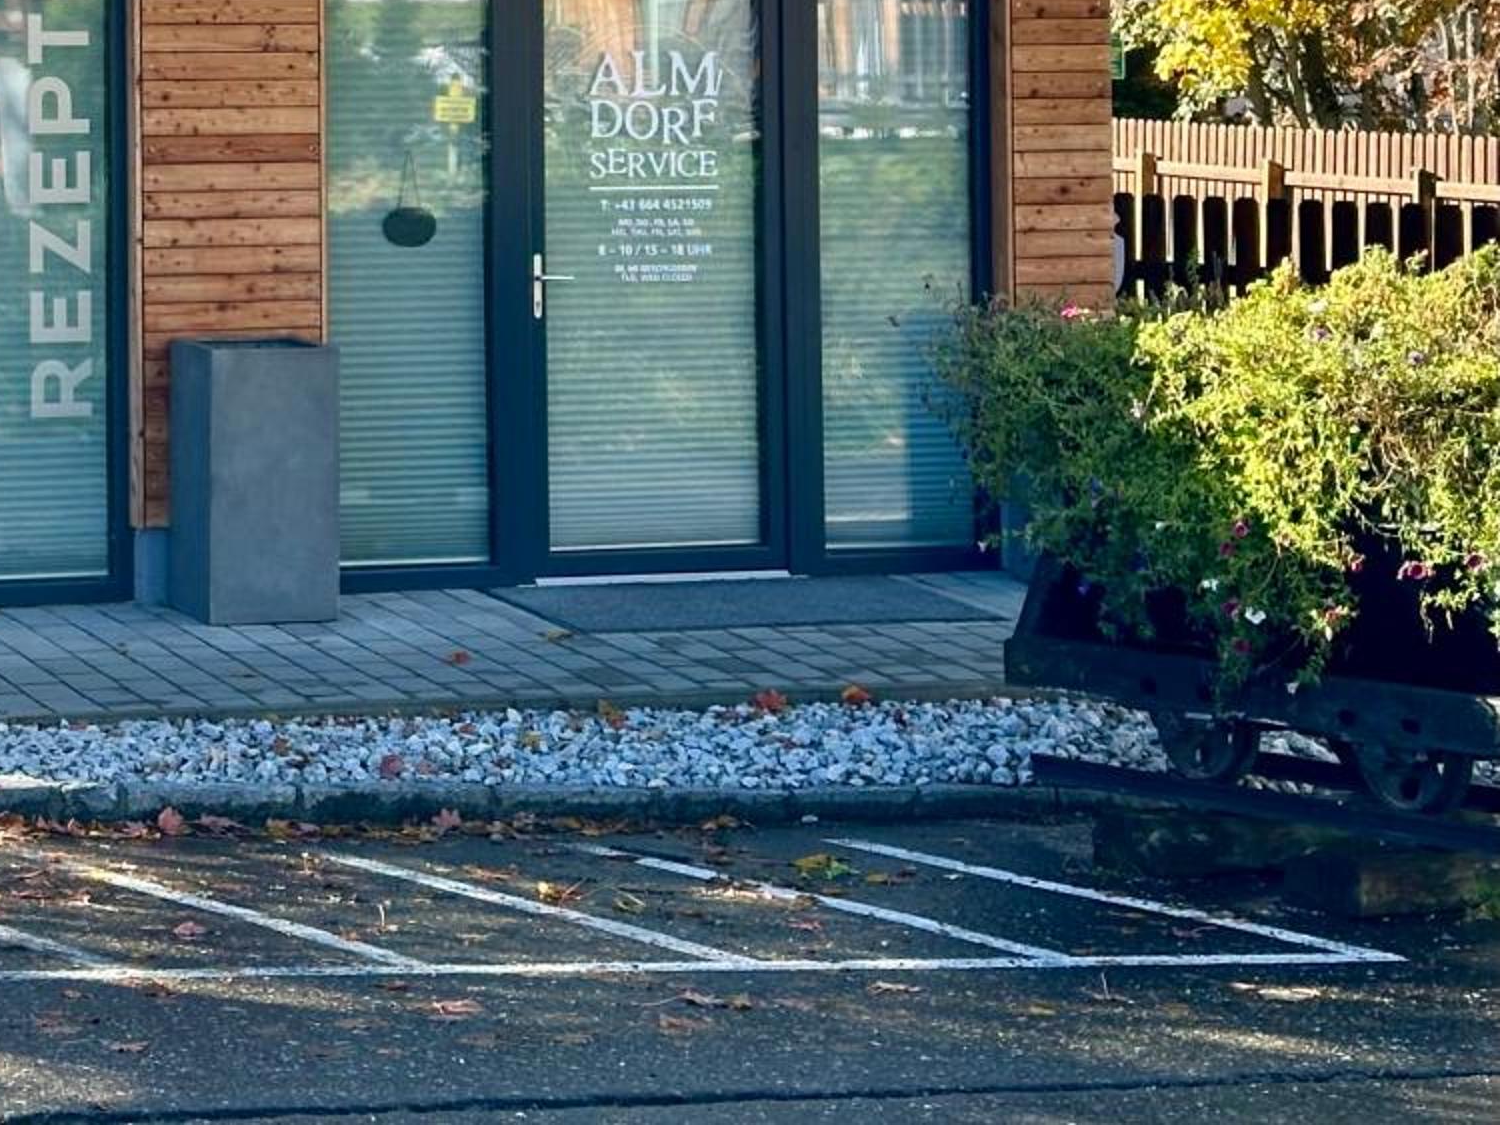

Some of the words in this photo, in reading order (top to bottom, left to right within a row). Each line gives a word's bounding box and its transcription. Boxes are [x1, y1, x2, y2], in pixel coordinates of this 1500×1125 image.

[589, 50, 720, 96] ALM
[590, 98, 719, 145] DORF
[589, 148, 719, 179] SERVICE
[618, 244, 633, 256] 10
